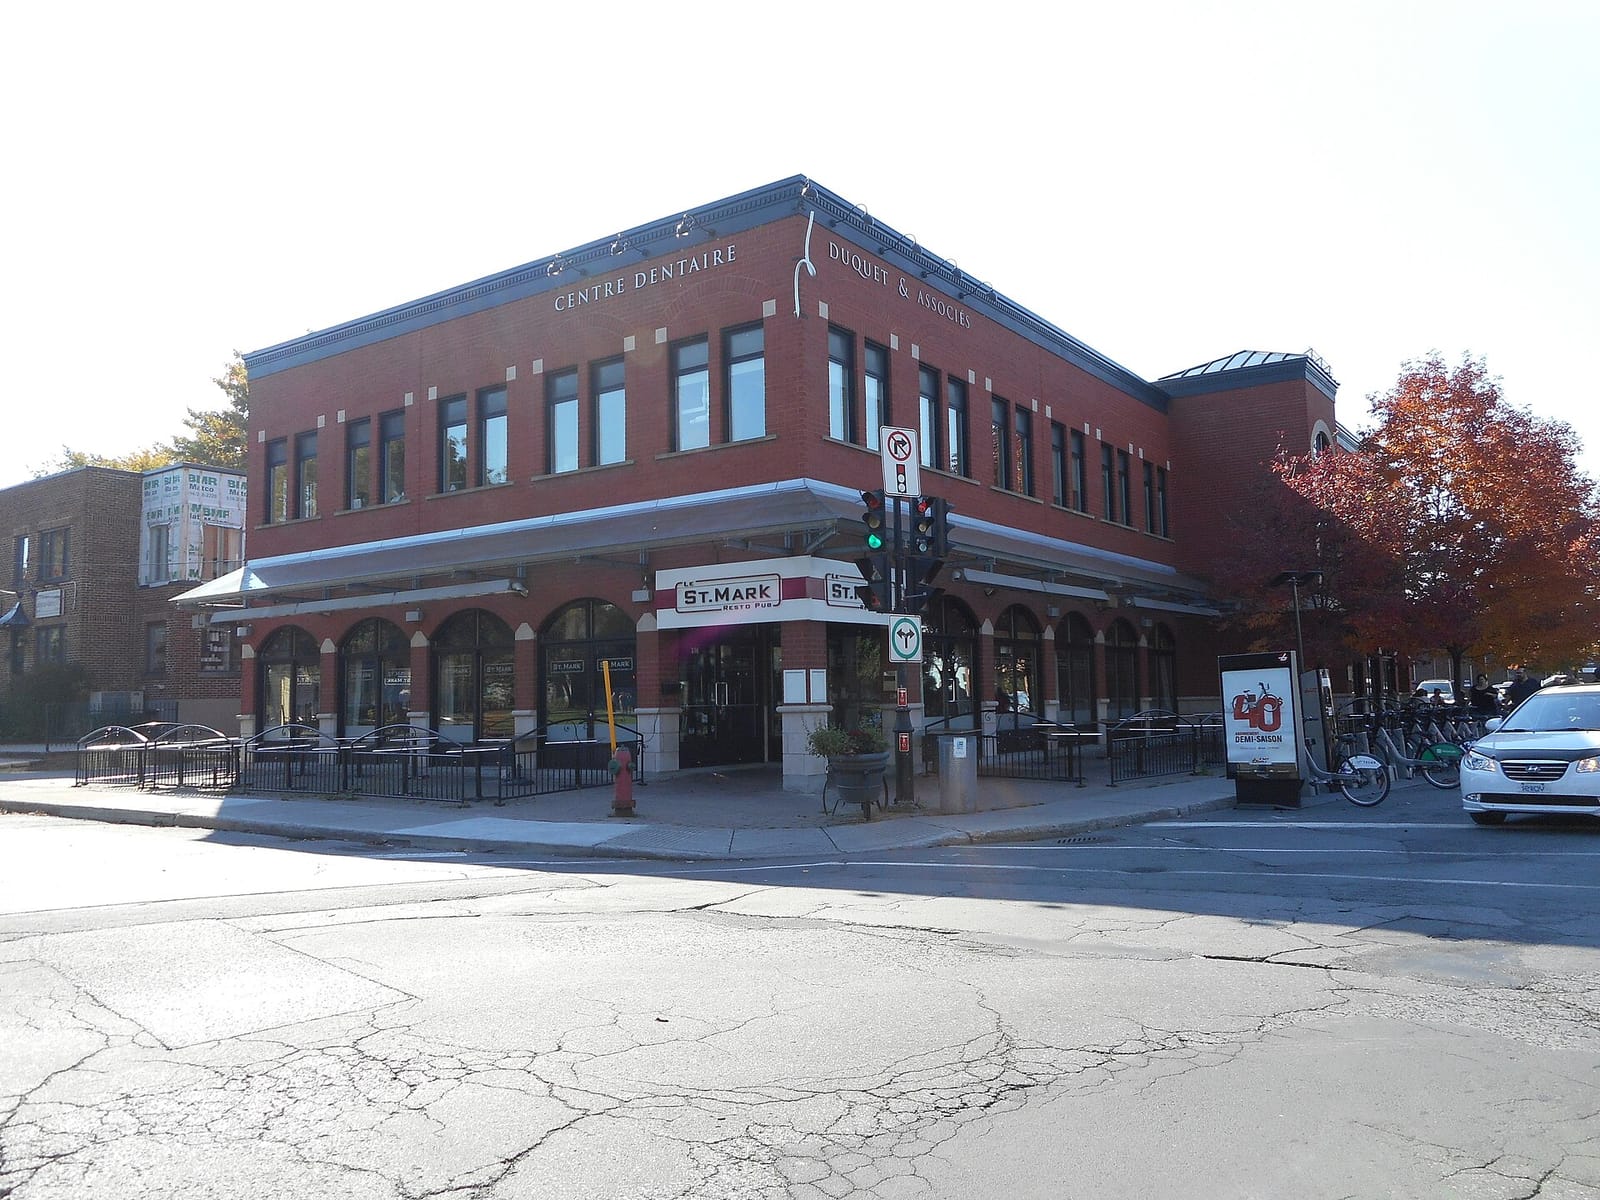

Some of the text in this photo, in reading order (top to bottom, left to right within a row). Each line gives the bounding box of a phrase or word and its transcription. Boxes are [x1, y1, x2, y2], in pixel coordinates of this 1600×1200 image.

[554, 244, 737, 312] CENTRE DENTAIRE
[829, 241, 970, 329] DUQUET & ASSOCIÉS
[228, 479, 247, 489] BM
[684, 584, 771, 605] ST.MARK
[832, 583, 857, 600] ST.
[1232, 694, 1282, 733] 40
[1235, 735, 1283, 743] DEMI-SAISON
